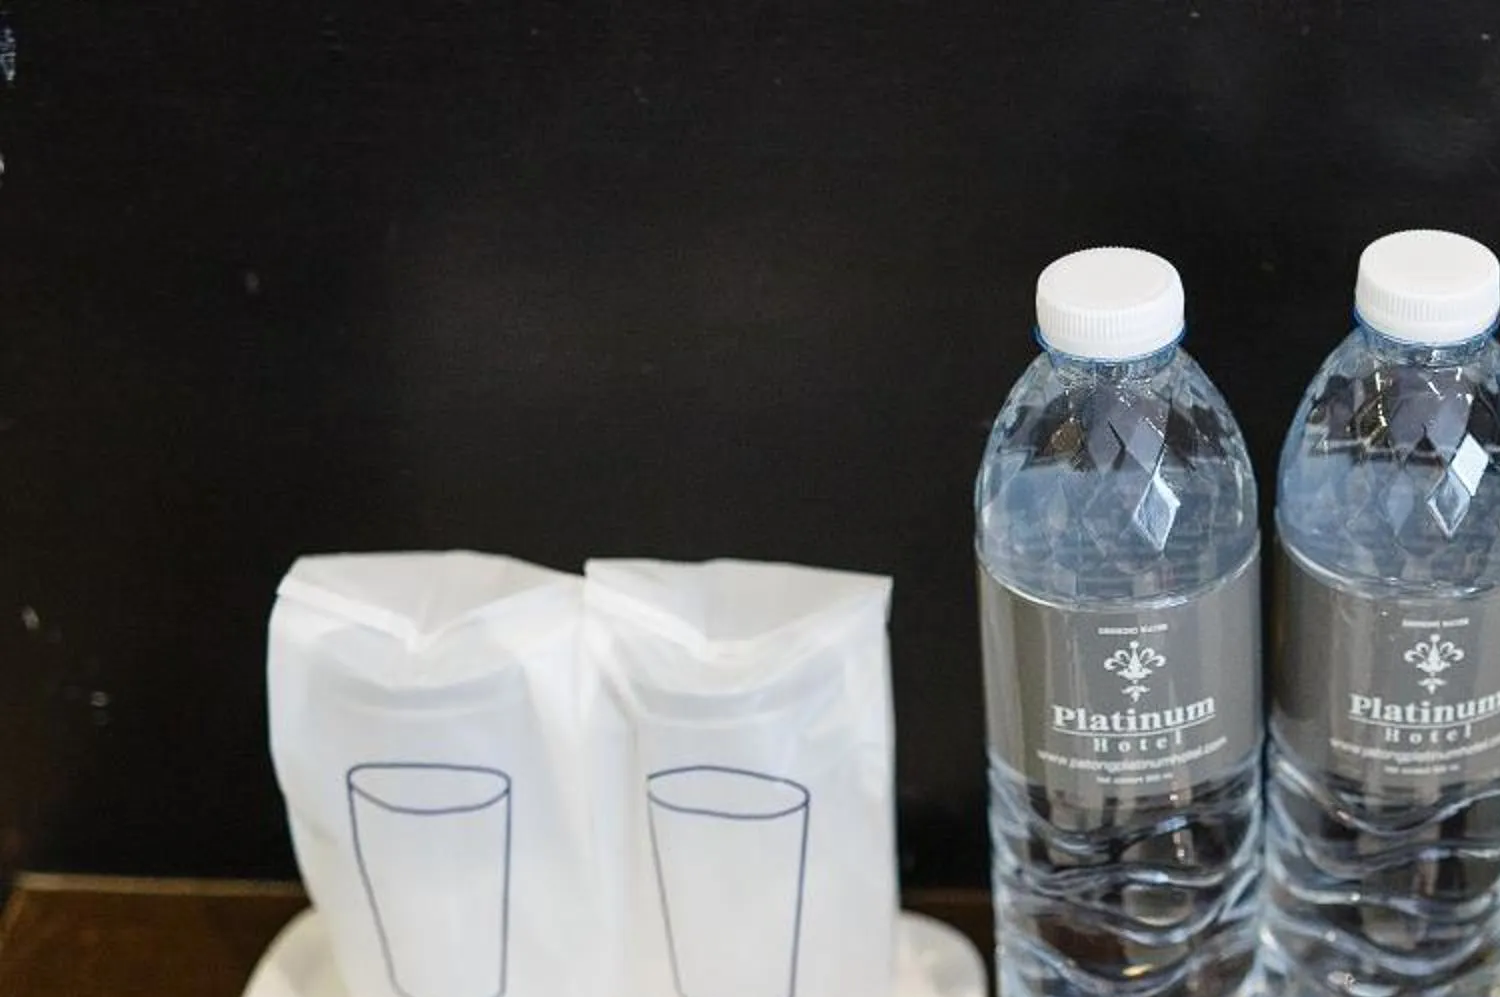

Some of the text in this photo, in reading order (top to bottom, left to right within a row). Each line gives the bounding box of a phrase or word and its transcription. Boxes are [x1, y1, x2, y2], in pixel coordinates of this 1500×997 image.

[1052, 697, 1215, 732] Platinum
[1093, 729, 1182, 753] Hotel
[1385, 722, 1472, 744] Hotel
